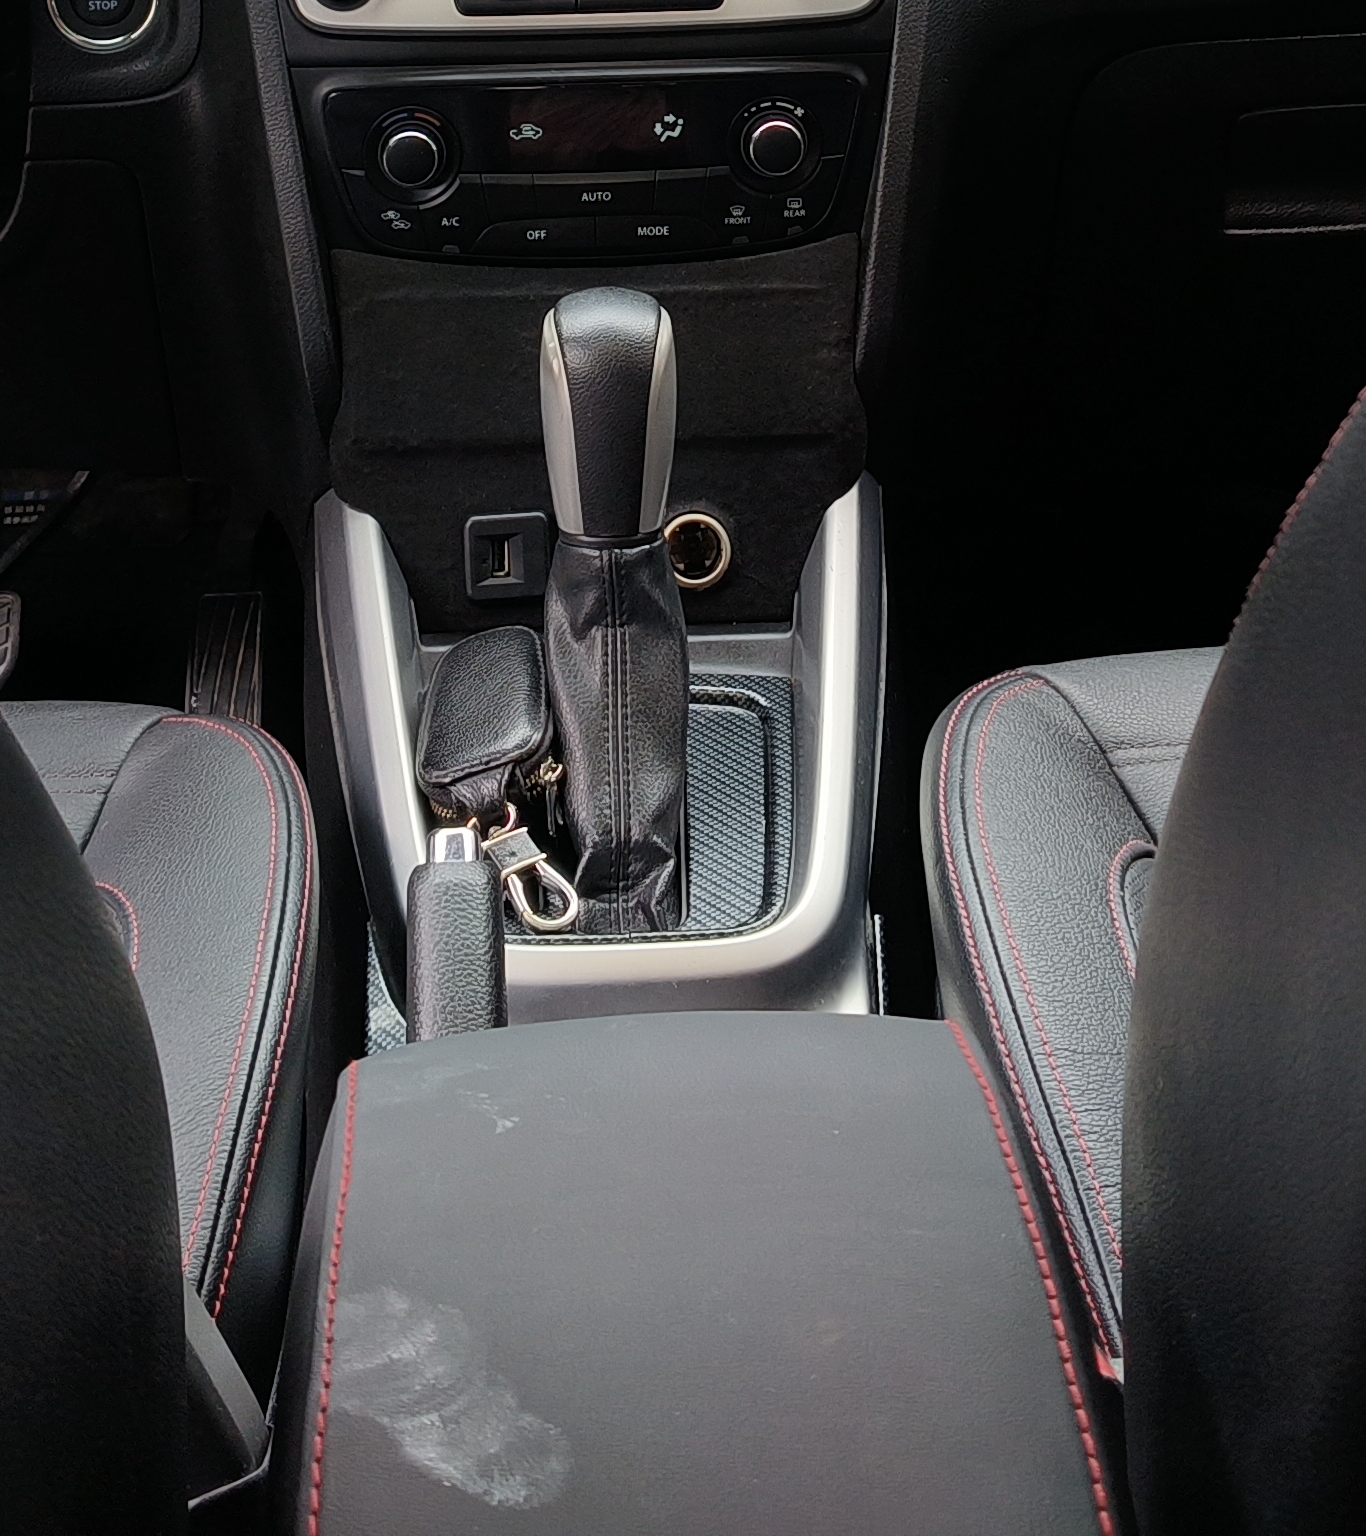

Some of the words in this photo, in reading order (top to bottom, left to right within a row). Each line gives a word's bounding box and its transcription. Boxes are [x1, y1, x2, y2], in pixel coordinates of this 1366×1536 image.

[88, 0, 118, 11] STOP
[581, 191, 612, 202] AUTO
[783, 209, 806, 218] REAR
[441, 216, 461, 227] A/C
[724, 216, 752, 225] FRONT
[526, 229, 548, 241] OFF
[637, 226, 671, 237] MODE
